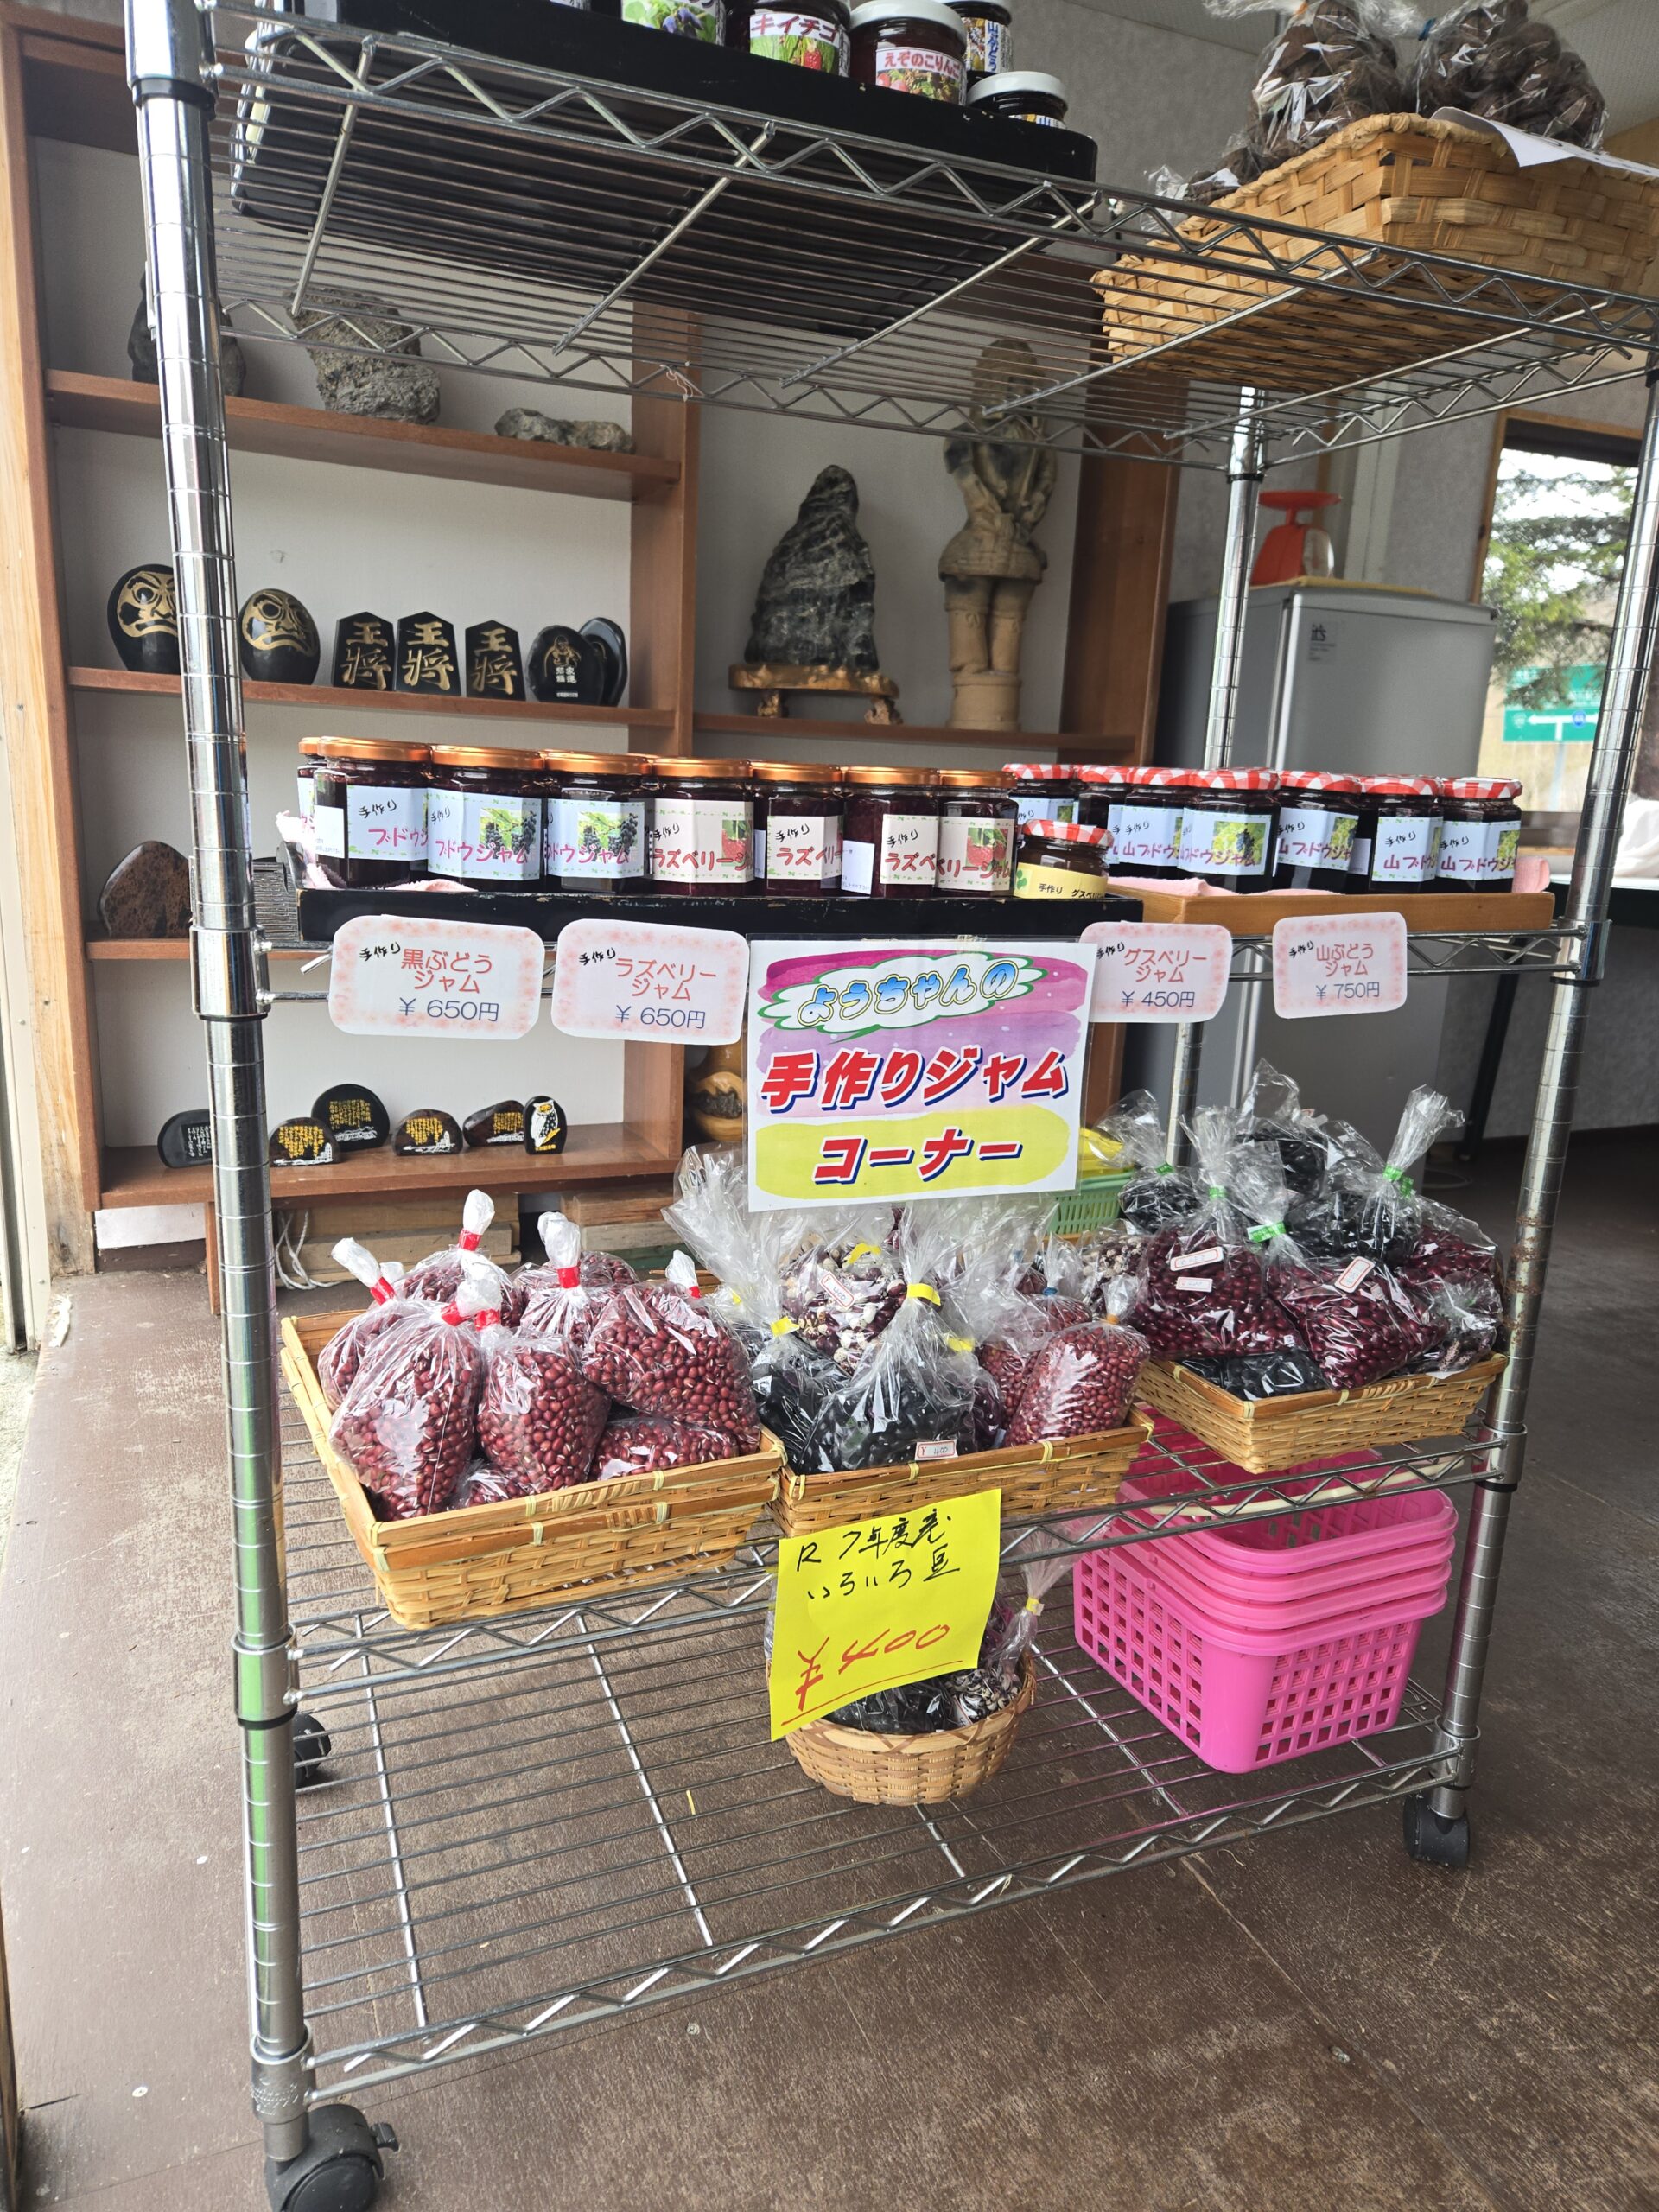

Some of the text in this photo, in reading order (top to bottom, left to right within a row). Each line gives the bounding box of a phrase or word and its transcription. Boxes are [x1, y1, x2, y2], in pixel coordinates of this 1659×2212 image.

[751, 13, 838, 42] キイチゴ
[884, 50, 961, 79] えぞのこりんご
[359, 799, 397, 819] 手作り
[431, 806, 451, 825] 手作り
[653, 822, 680, 841] 手作り
[775, 823, 810, 843] 手作り
[1126, 820, 1150, 835] 手作り
[887, 830, 918, 848] 手作り
[1384, 830, 1416, 848] 手作り
[1440, 836, 1469, 850] 手作り
[435, 839, 529, 865] ブドウジャム
[1039, 883, 1063, 895] 手作り
[359, 942, 401, 962] 手作り
[579, 948, 616, 965] 手作り
[1096, 941, 1125, 960] 手作り
[1123, 948, 1207, 968] グスベリー
[1288, 940, 1314, 959] 手作り
[1316, 943, 1374, 962] 山ぶどう
[401, 948, 493, 975] 黒ぶどう
[614, 957, 717, 982] ラズベリー
[1325, 960, 1369, 978] ジャム
[414, 970, 481, 995] ジャム
[1135, 965, 1185, 984] ジャム
[631, 977, 691, 1001] ジャム
[797, 958, 1020, 1027] ようちゃんの
[1333, 981, 1380, 1000] 750円
[1141, 991, 1195, 1008] 450円
[427, 999, 499, 1022] 650円
[640, 1007, 706, 1029] 650円
[760, 1044, 1070, 1114] 手作りジャム
[812, 1127, 1024, 1185] コーナー
